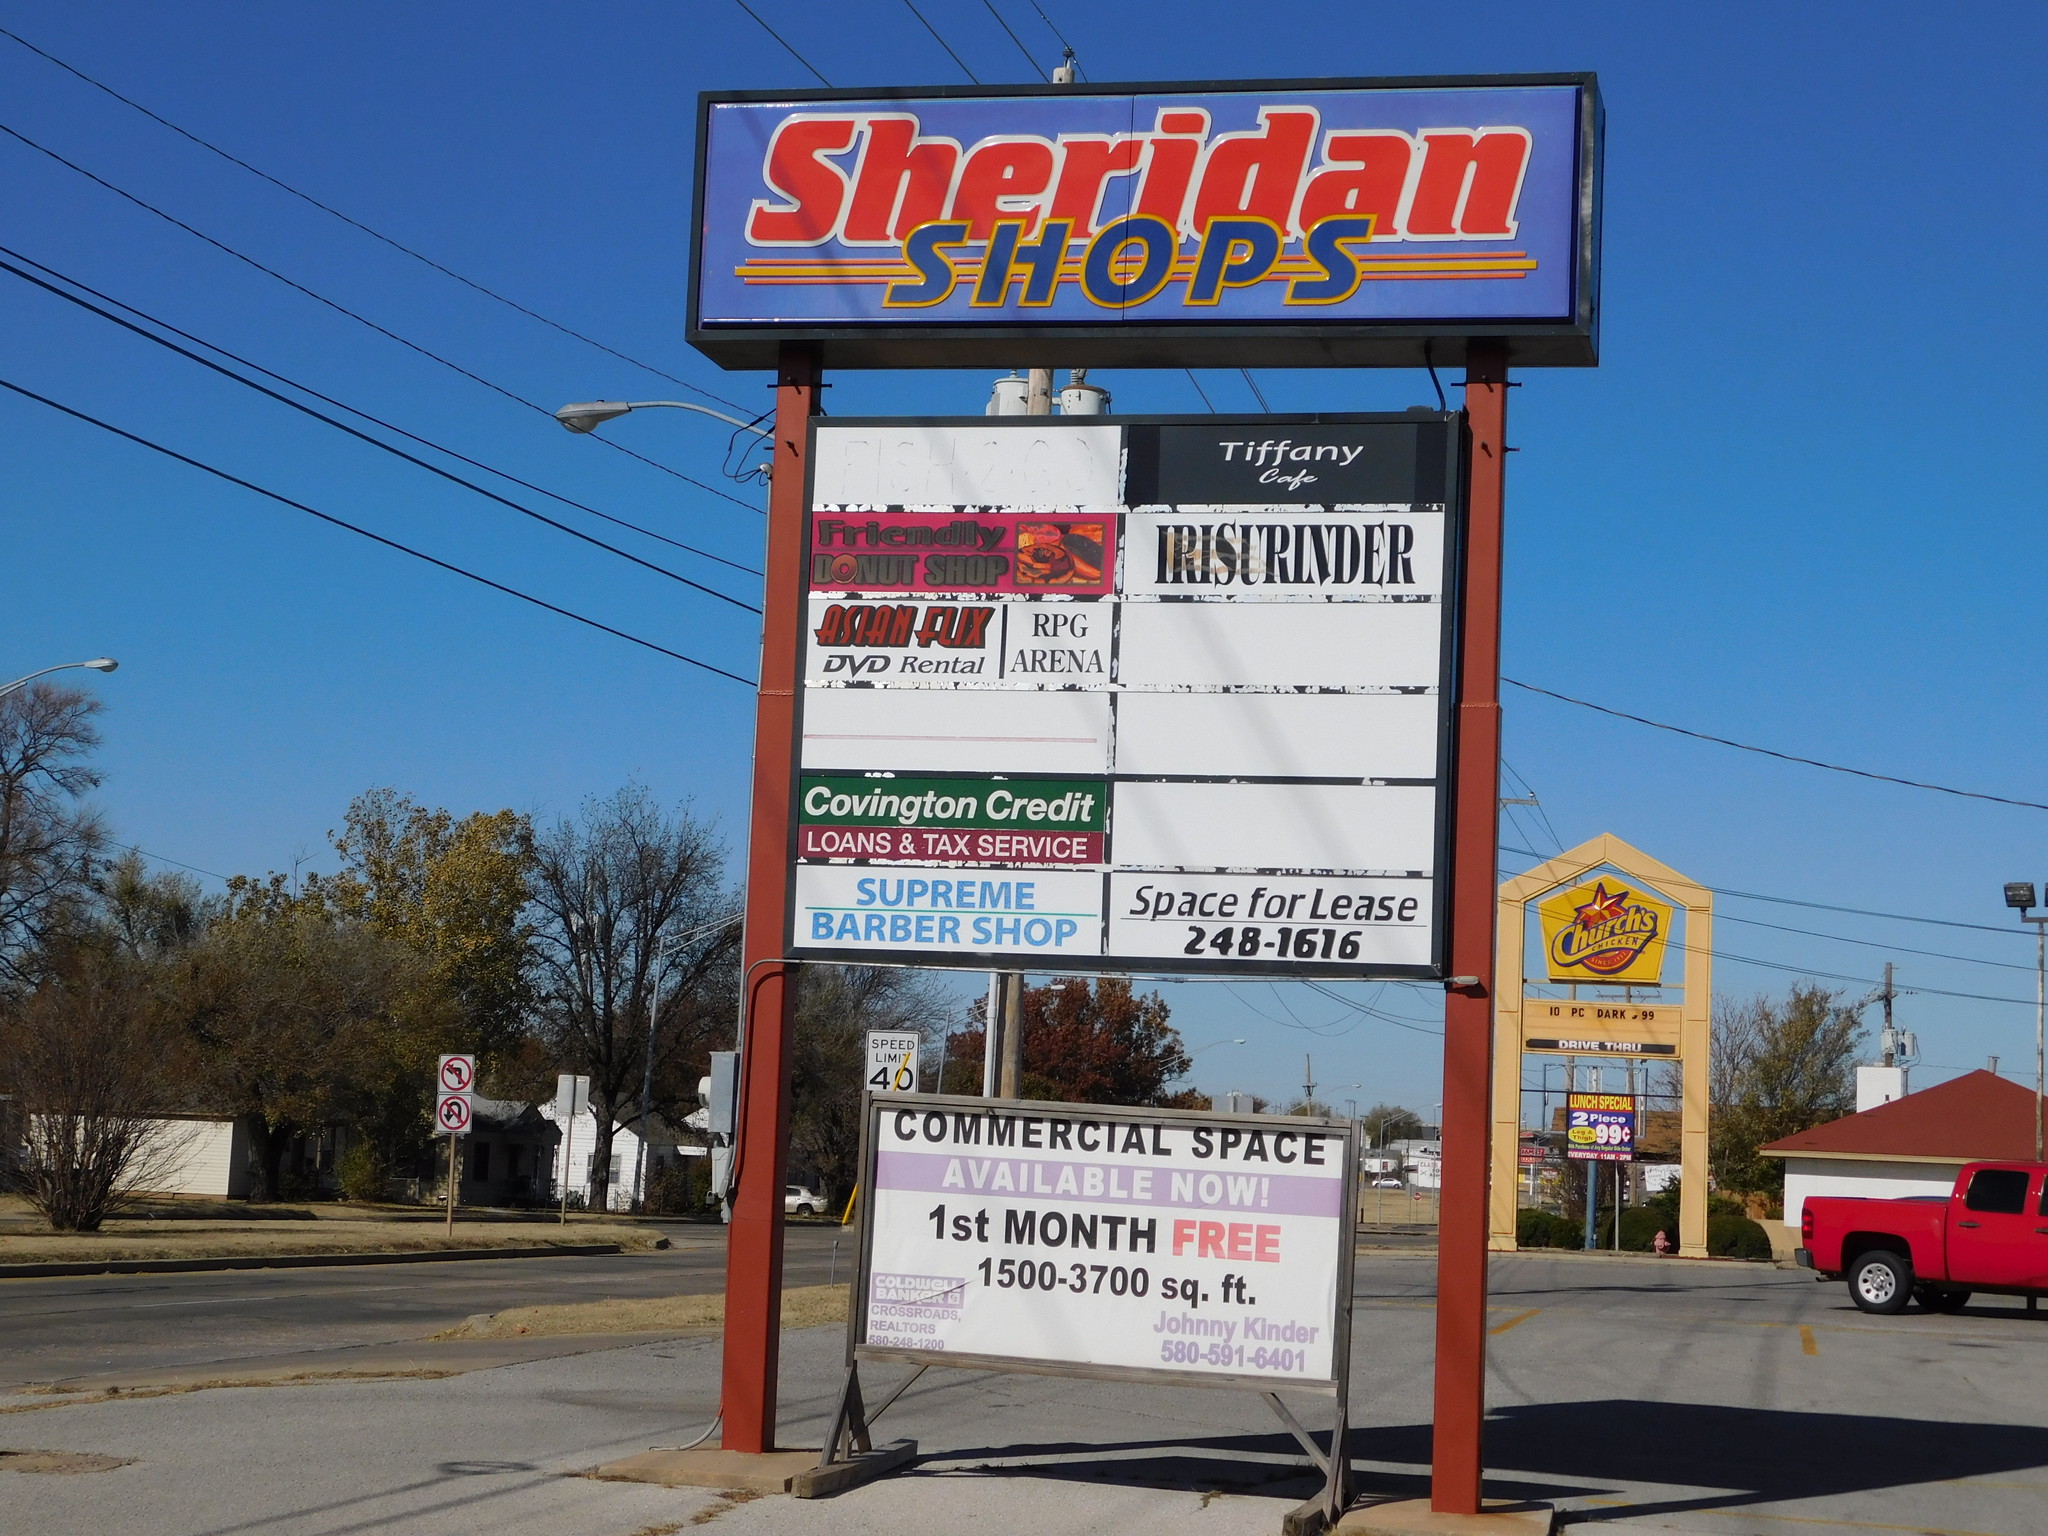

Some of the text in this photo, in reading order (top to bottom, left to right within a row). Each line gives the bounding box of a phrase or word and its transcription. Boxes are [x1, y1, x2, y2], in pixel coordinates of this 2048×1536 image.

[745, 105, 1533, 247] Sheridan
[882, 213, 1377, 308] SHOPS
[1218, 440, 1364, 466] Tiffany
[1258, 468, 1318, 491] Cafe
[817, 519, 1008, 552] Friendly
[812, 553, 1008, 586] DONUT SHOP
[814, 604, 995, 649] ASIAN FLIX
[1032, 613, 1089, 638] RPG
[823, 654, 985, 677] DVD Rental
[1010, 649, 1105, 674] ARENA
[804, 786, 1095, 825] Covington Credit
[807, 831, 1087, 859] LOANS & TAX SERVICE
[856, 877, 1035, 910] SUPREME
[1129, 885, 1419, 922] Space for Lease
[811, 912, 1078, 947] BARBER SHOP
[1184, 925, 1363, 959] 248-1616
[1553, 907, 1655, 963] Church's
[1591, 936, 1638, 952] CHICKEN
[1571, 1008, 1585, 1017] PC
[1597, 1009, 1626, 1019] DARK
[872, 1039, 915, 1050] SPEED
[1559, 1040, 1642, 1052] DRIVE THRU
[869, 1067, 913, 1090] 40
[1569, 1094, 1632, 1110] LUNCH SPECIAL
[1572, 1111, 1626, 1125] 2 Piece
[894, 1109, 1327, 1165] COMMERCIAL SPACE
[1567, 1151, 1598, 1159] EVERYDAY
[942, 1158, 1269, 1207] AVAILABLE NOW!
[928, 1204, 1281, 1263] 1st MONTH FREE
[876, 1288, 945, 1304] BANKER
[977, 1257, 1256, 1309] 1500-3700 sq. ft.
[870, 1320, 936, 1334] REALTORS
[871, 1305, 962, 1322] CROSSROADS,
[1153, 1310, 1319, 1344] Johnny Kinder
[868, 1335, 945, 1350] 580-248-1200
[1161, 1340, 1305, 1372] 580-591-6401
